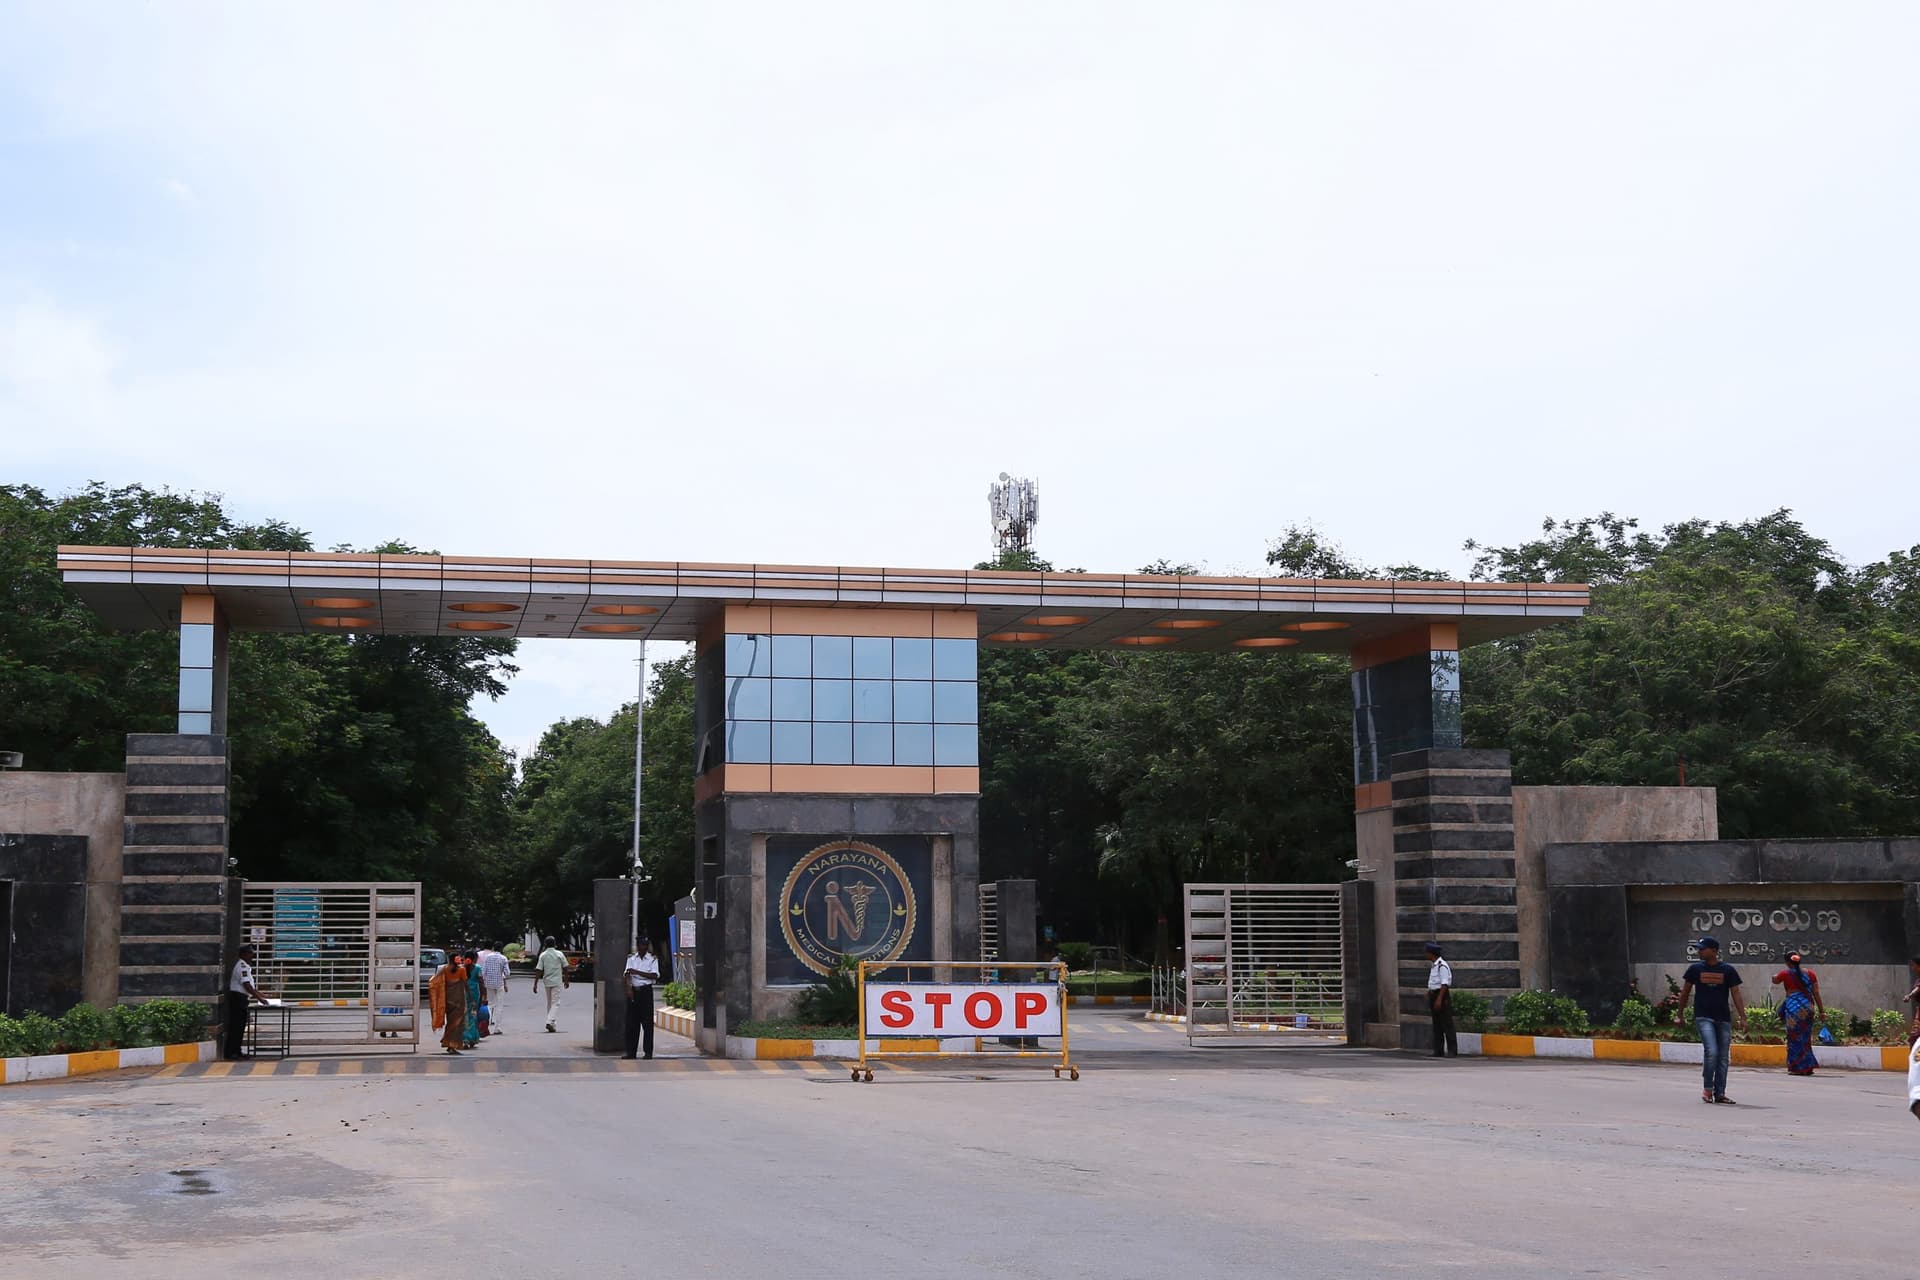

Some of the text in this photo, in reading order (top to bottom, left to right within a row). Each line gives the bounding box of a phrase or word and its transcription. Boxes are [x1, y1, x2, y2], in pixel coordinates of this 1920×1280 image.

[807, 853, 887, 875] NARAYANA
[1691, 904, 1842, 932] నారాయణ
[796, 928, 838, 965] MEDICAL
[879, 990, 1048, 1030] STOP
